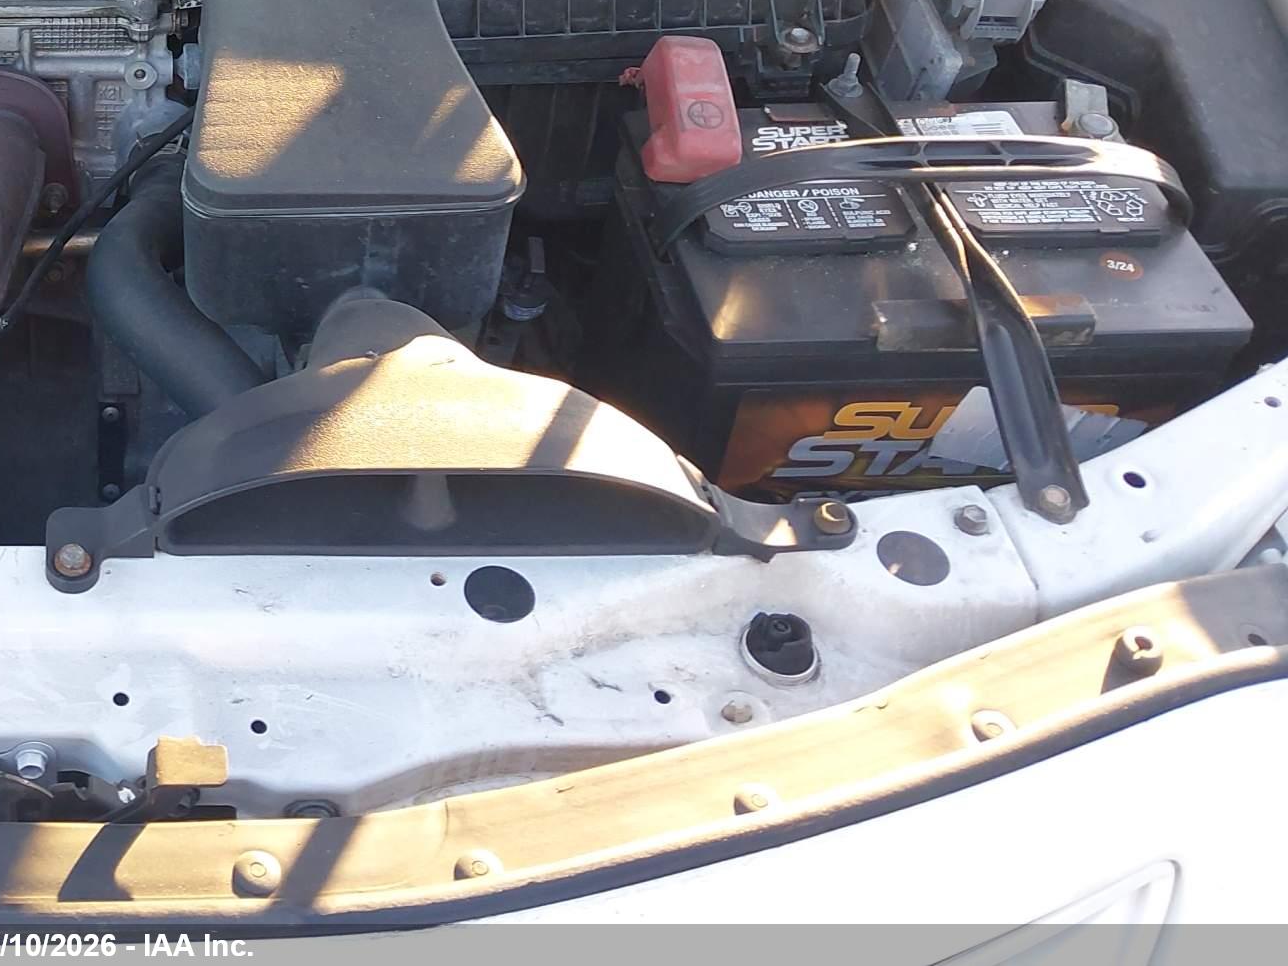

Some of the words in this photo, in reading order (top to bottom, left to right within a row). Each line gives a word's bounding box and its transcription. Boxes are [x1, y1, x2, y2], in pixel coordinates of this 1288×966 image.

[757, 125, 846, 139] SUPER
[802, 189, 810, 198] /
[812, 188, 861, 197] POISON
[1106, 259, 1135, 273] 3/24
